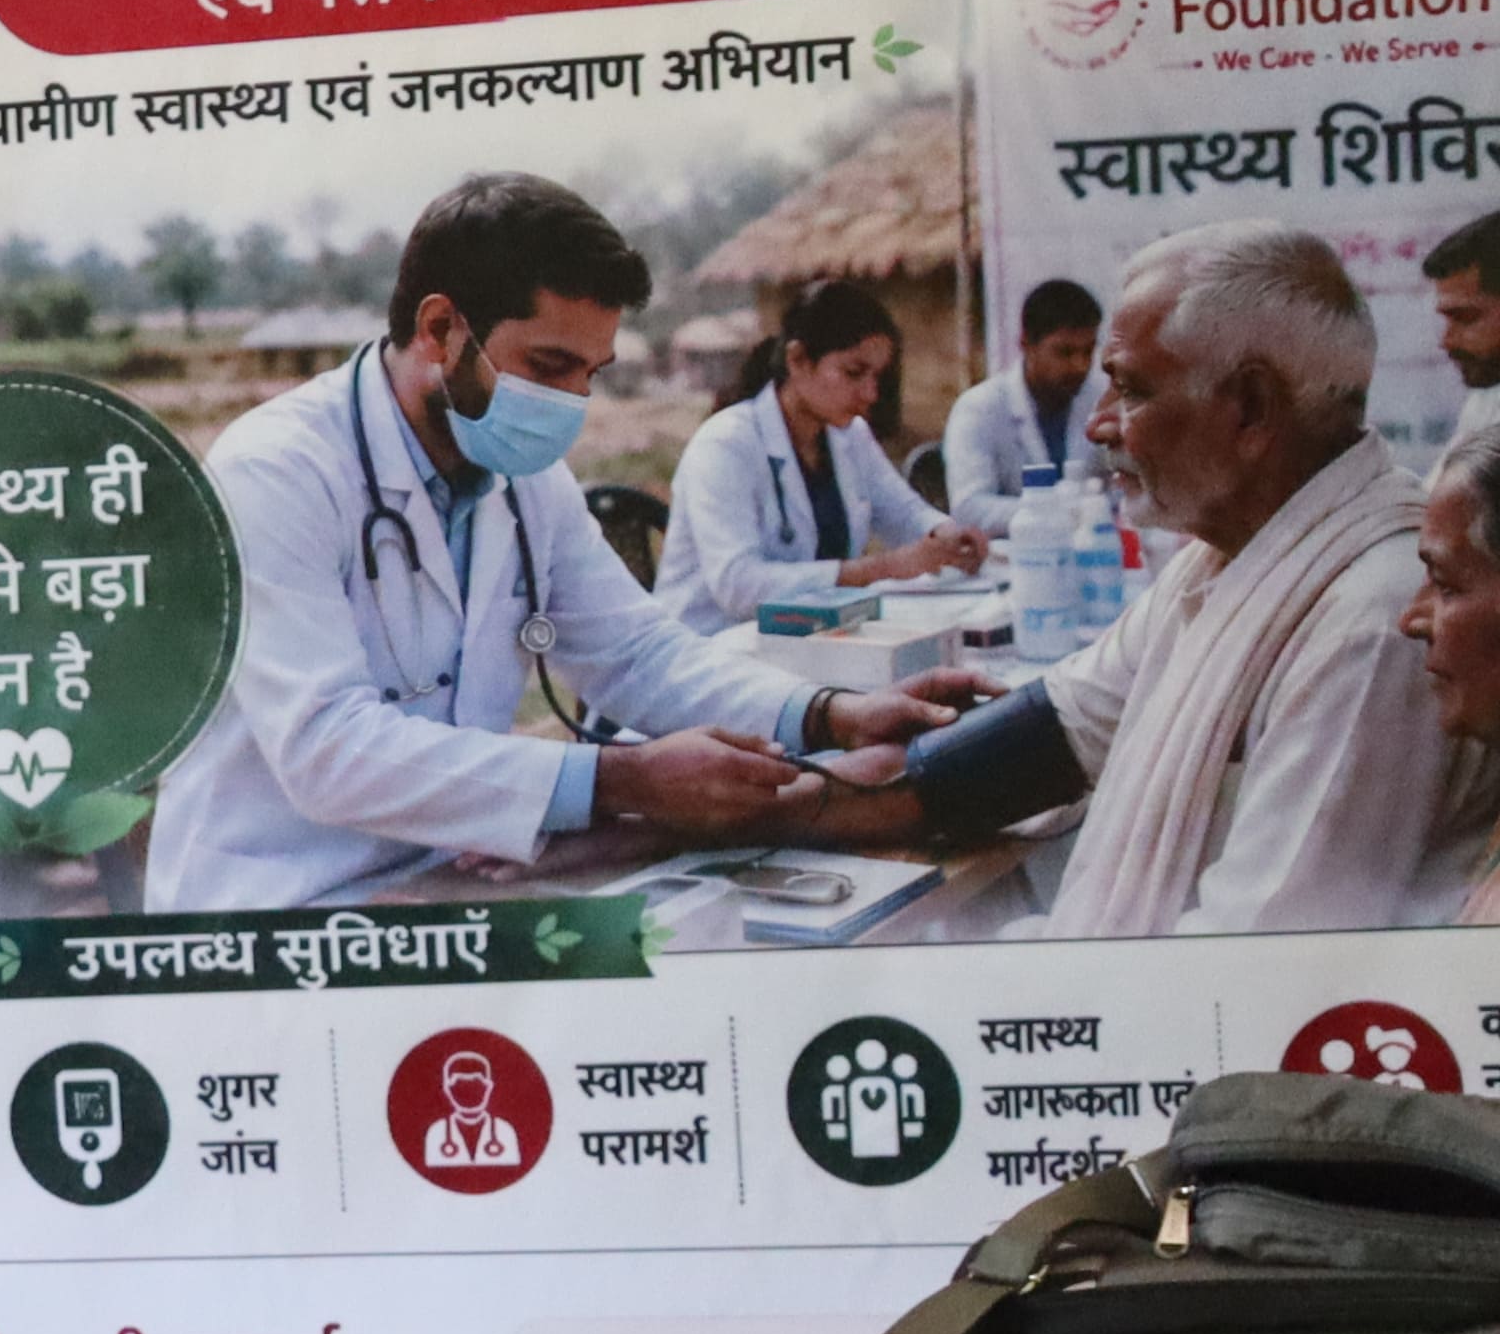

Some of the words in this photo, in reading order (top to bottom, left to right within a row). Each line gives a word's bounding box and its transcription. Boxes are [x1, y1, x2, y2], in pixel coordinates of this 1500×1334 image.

[1213, 50, 1251, 71] We
[1260, 46, 1315, 68] Care
[1341, 41, 1381, 64] We
[1387, 37, 1460, 61] Serve
[132, 81, 292, 133] स्वास्थ्य
[305, 62, 373, 121] एवं
[388, 54, 645, 112] जनकल्याण
[662, 31, 855, 91] अभियान
[1054, 129, 1297, 200] स्वास्थ्य
[85, 444, 147, 523] ही
[42, 555, 150, 622] बड़ा
[50, 632, 92, 710] है
[63, 931, 257, 981] उपलब्ध
[979, 1017, 1101, 1053] स्वास्थ्य
[197, 1074, 279, 1122] शुगर
[576, 1061, 707, 1098] स्वास्थ्य
[983, 1081, 1141, 1120] जागरूकता
[199, 1131, 278, 1174] जांच
[580, 1115, 709, 1165] परामर्श
